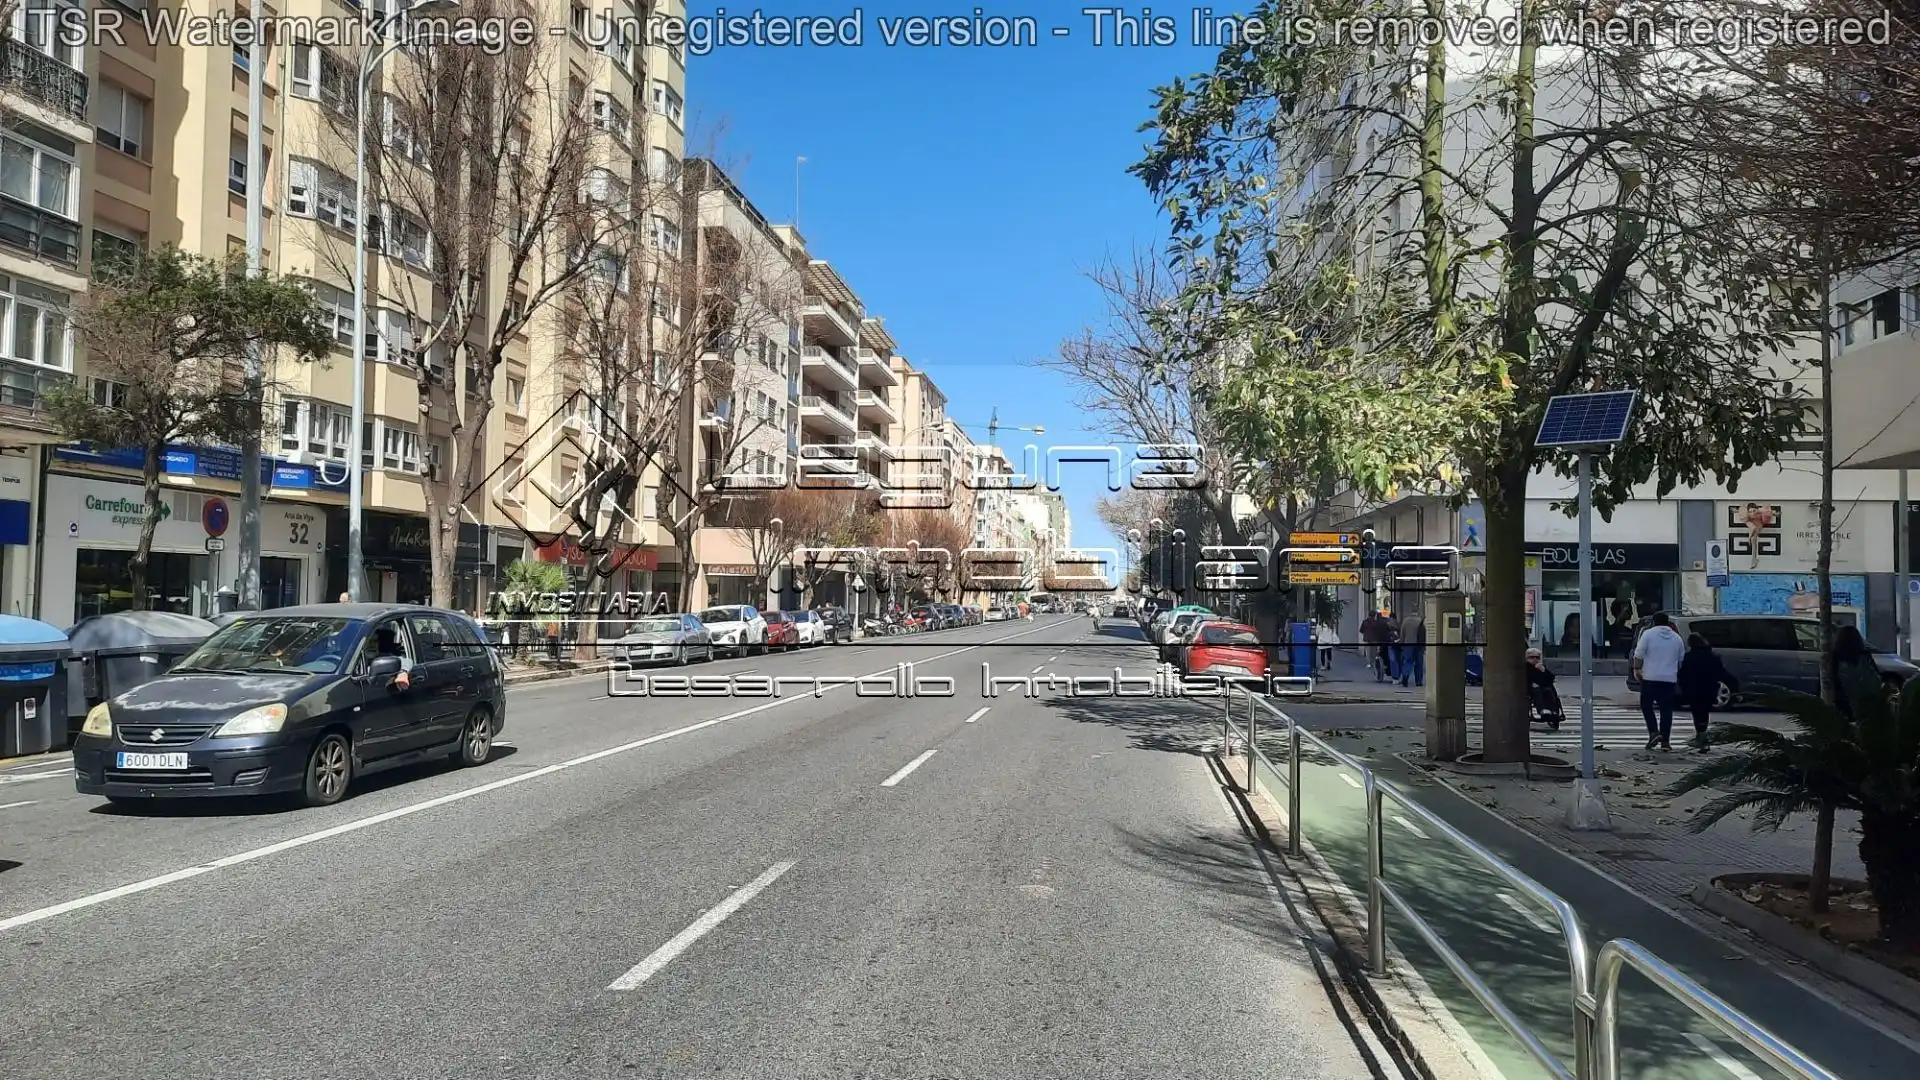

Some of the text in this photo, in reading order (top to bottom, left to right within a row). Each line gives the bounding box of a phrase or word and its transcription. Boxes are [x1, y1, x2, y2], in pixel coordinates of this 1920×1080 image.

[85, 494, 146, 514] Carrefour
[289, 522, 309, 545] 32
[1796, 531, 1852, 540] IRRESIBLE
[1354, 547, 1409, 561] OUGLAS
